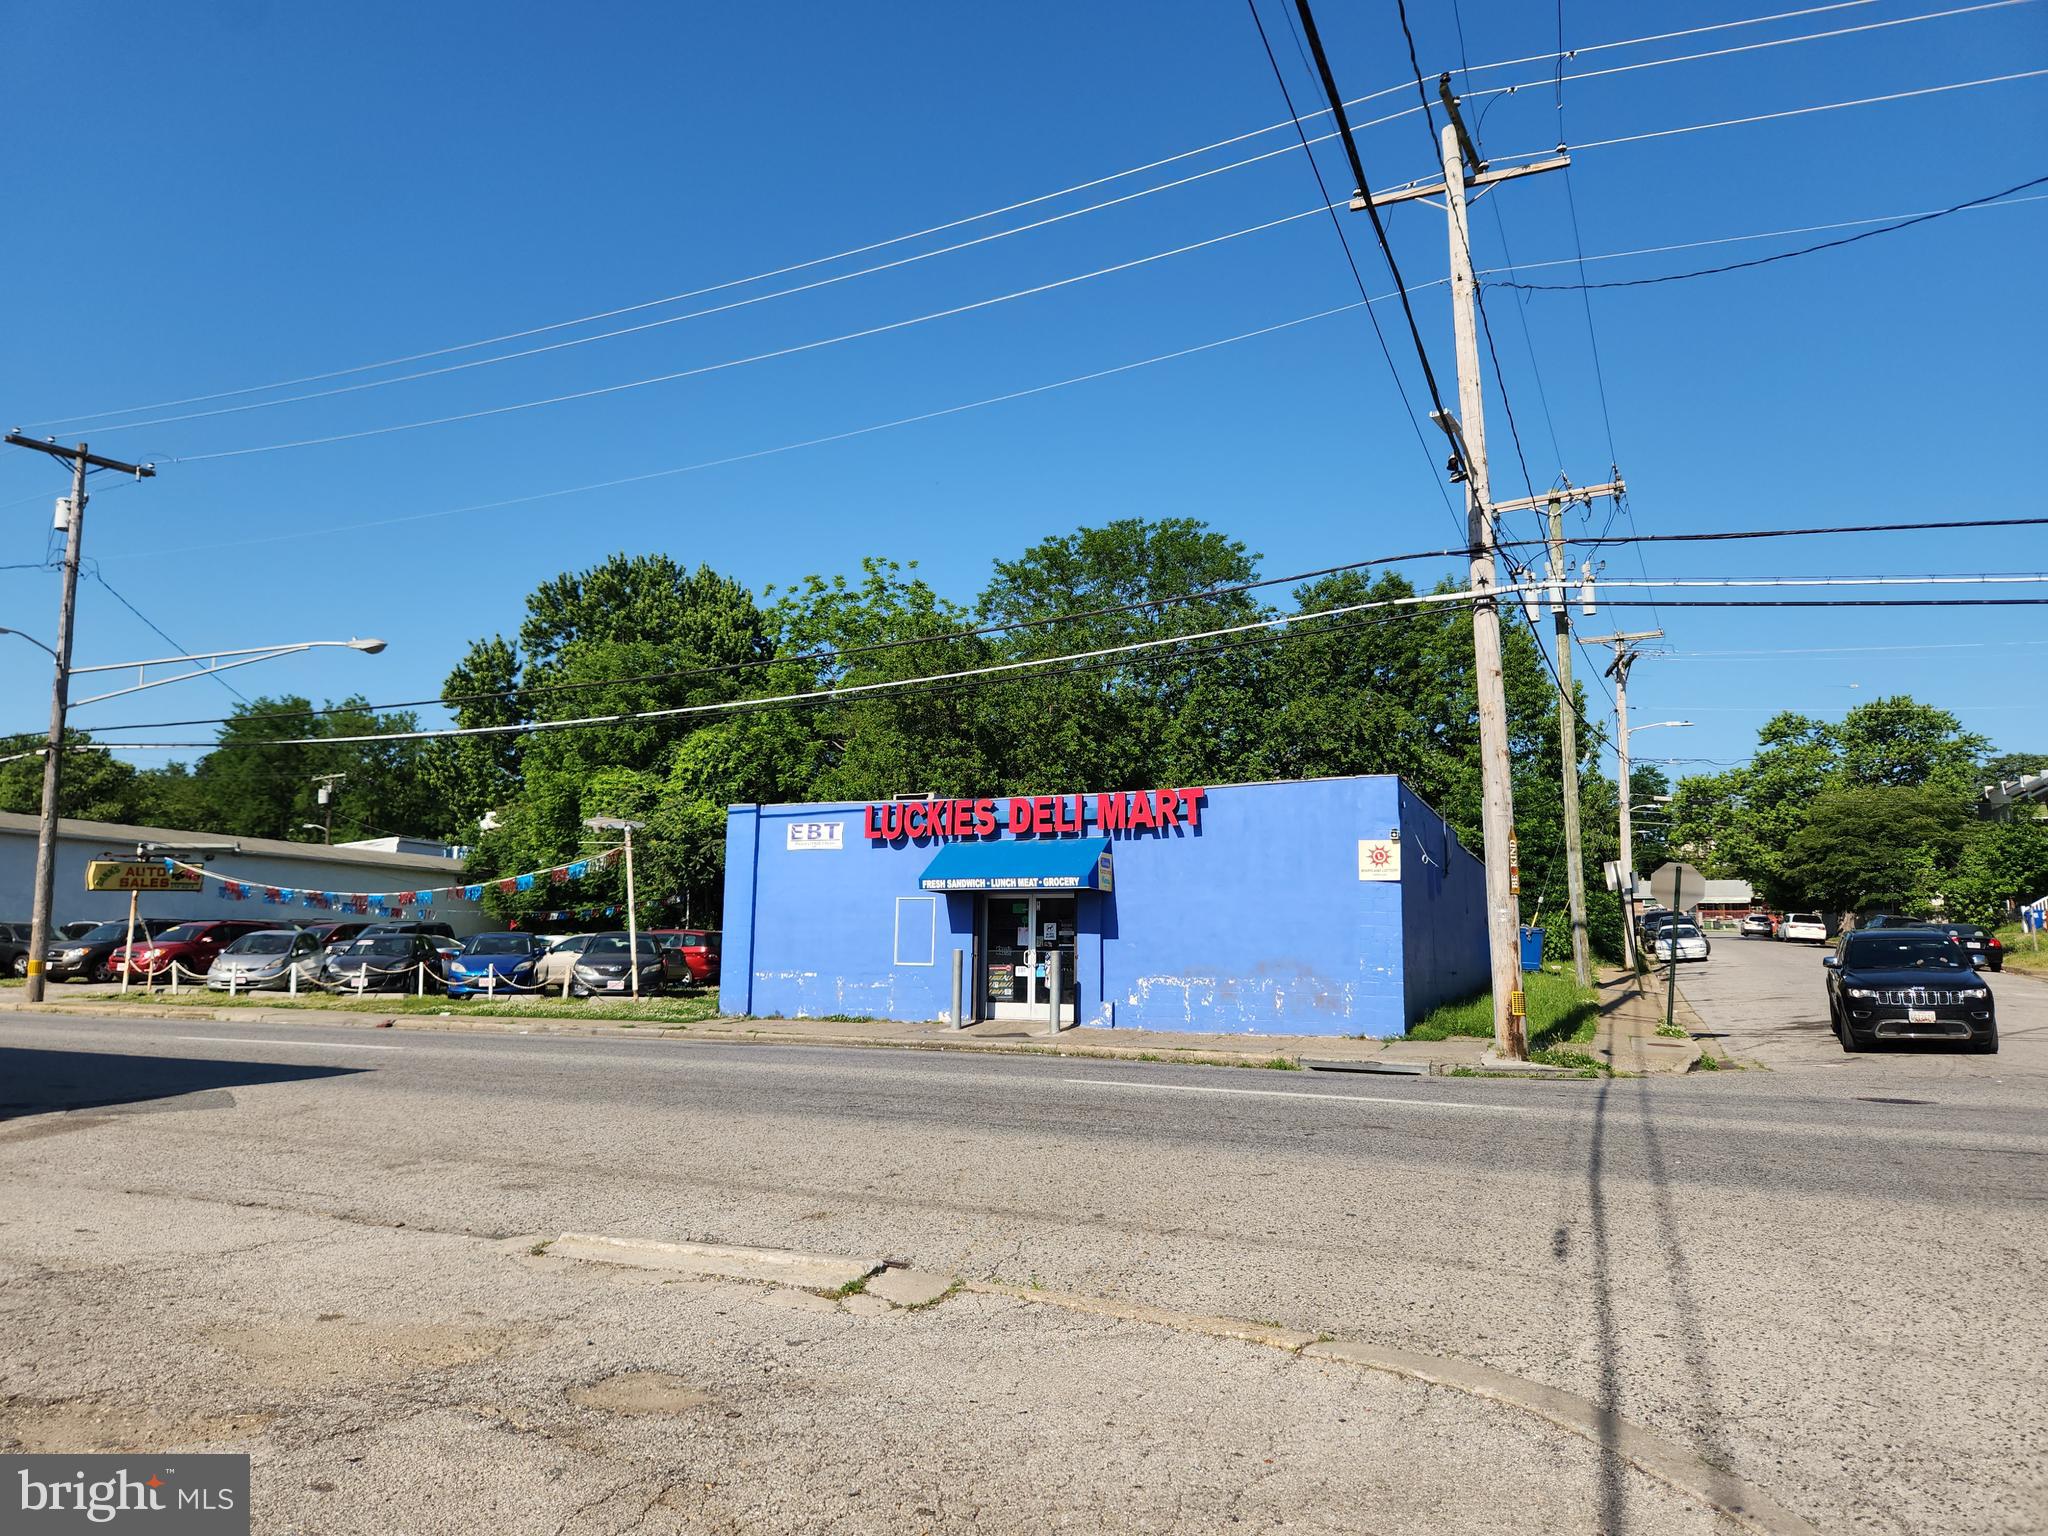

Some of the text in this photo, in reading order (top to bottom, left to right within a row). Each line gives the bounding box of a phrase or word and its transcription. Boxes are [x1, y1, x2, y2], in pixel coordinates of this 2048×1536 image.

[864, 788, 1205, 839] LUCKIES DELI MART
[791, 823, 841, 840] EBT
[125, 866, 167, 877] AUTO
[1510, 840, 1519, 888] BE KIND
[119, 878, 170, 888] SALES
[922, 876, 1080, 889] FRESH SANDWICH LUNCH MEAT GROCERY
